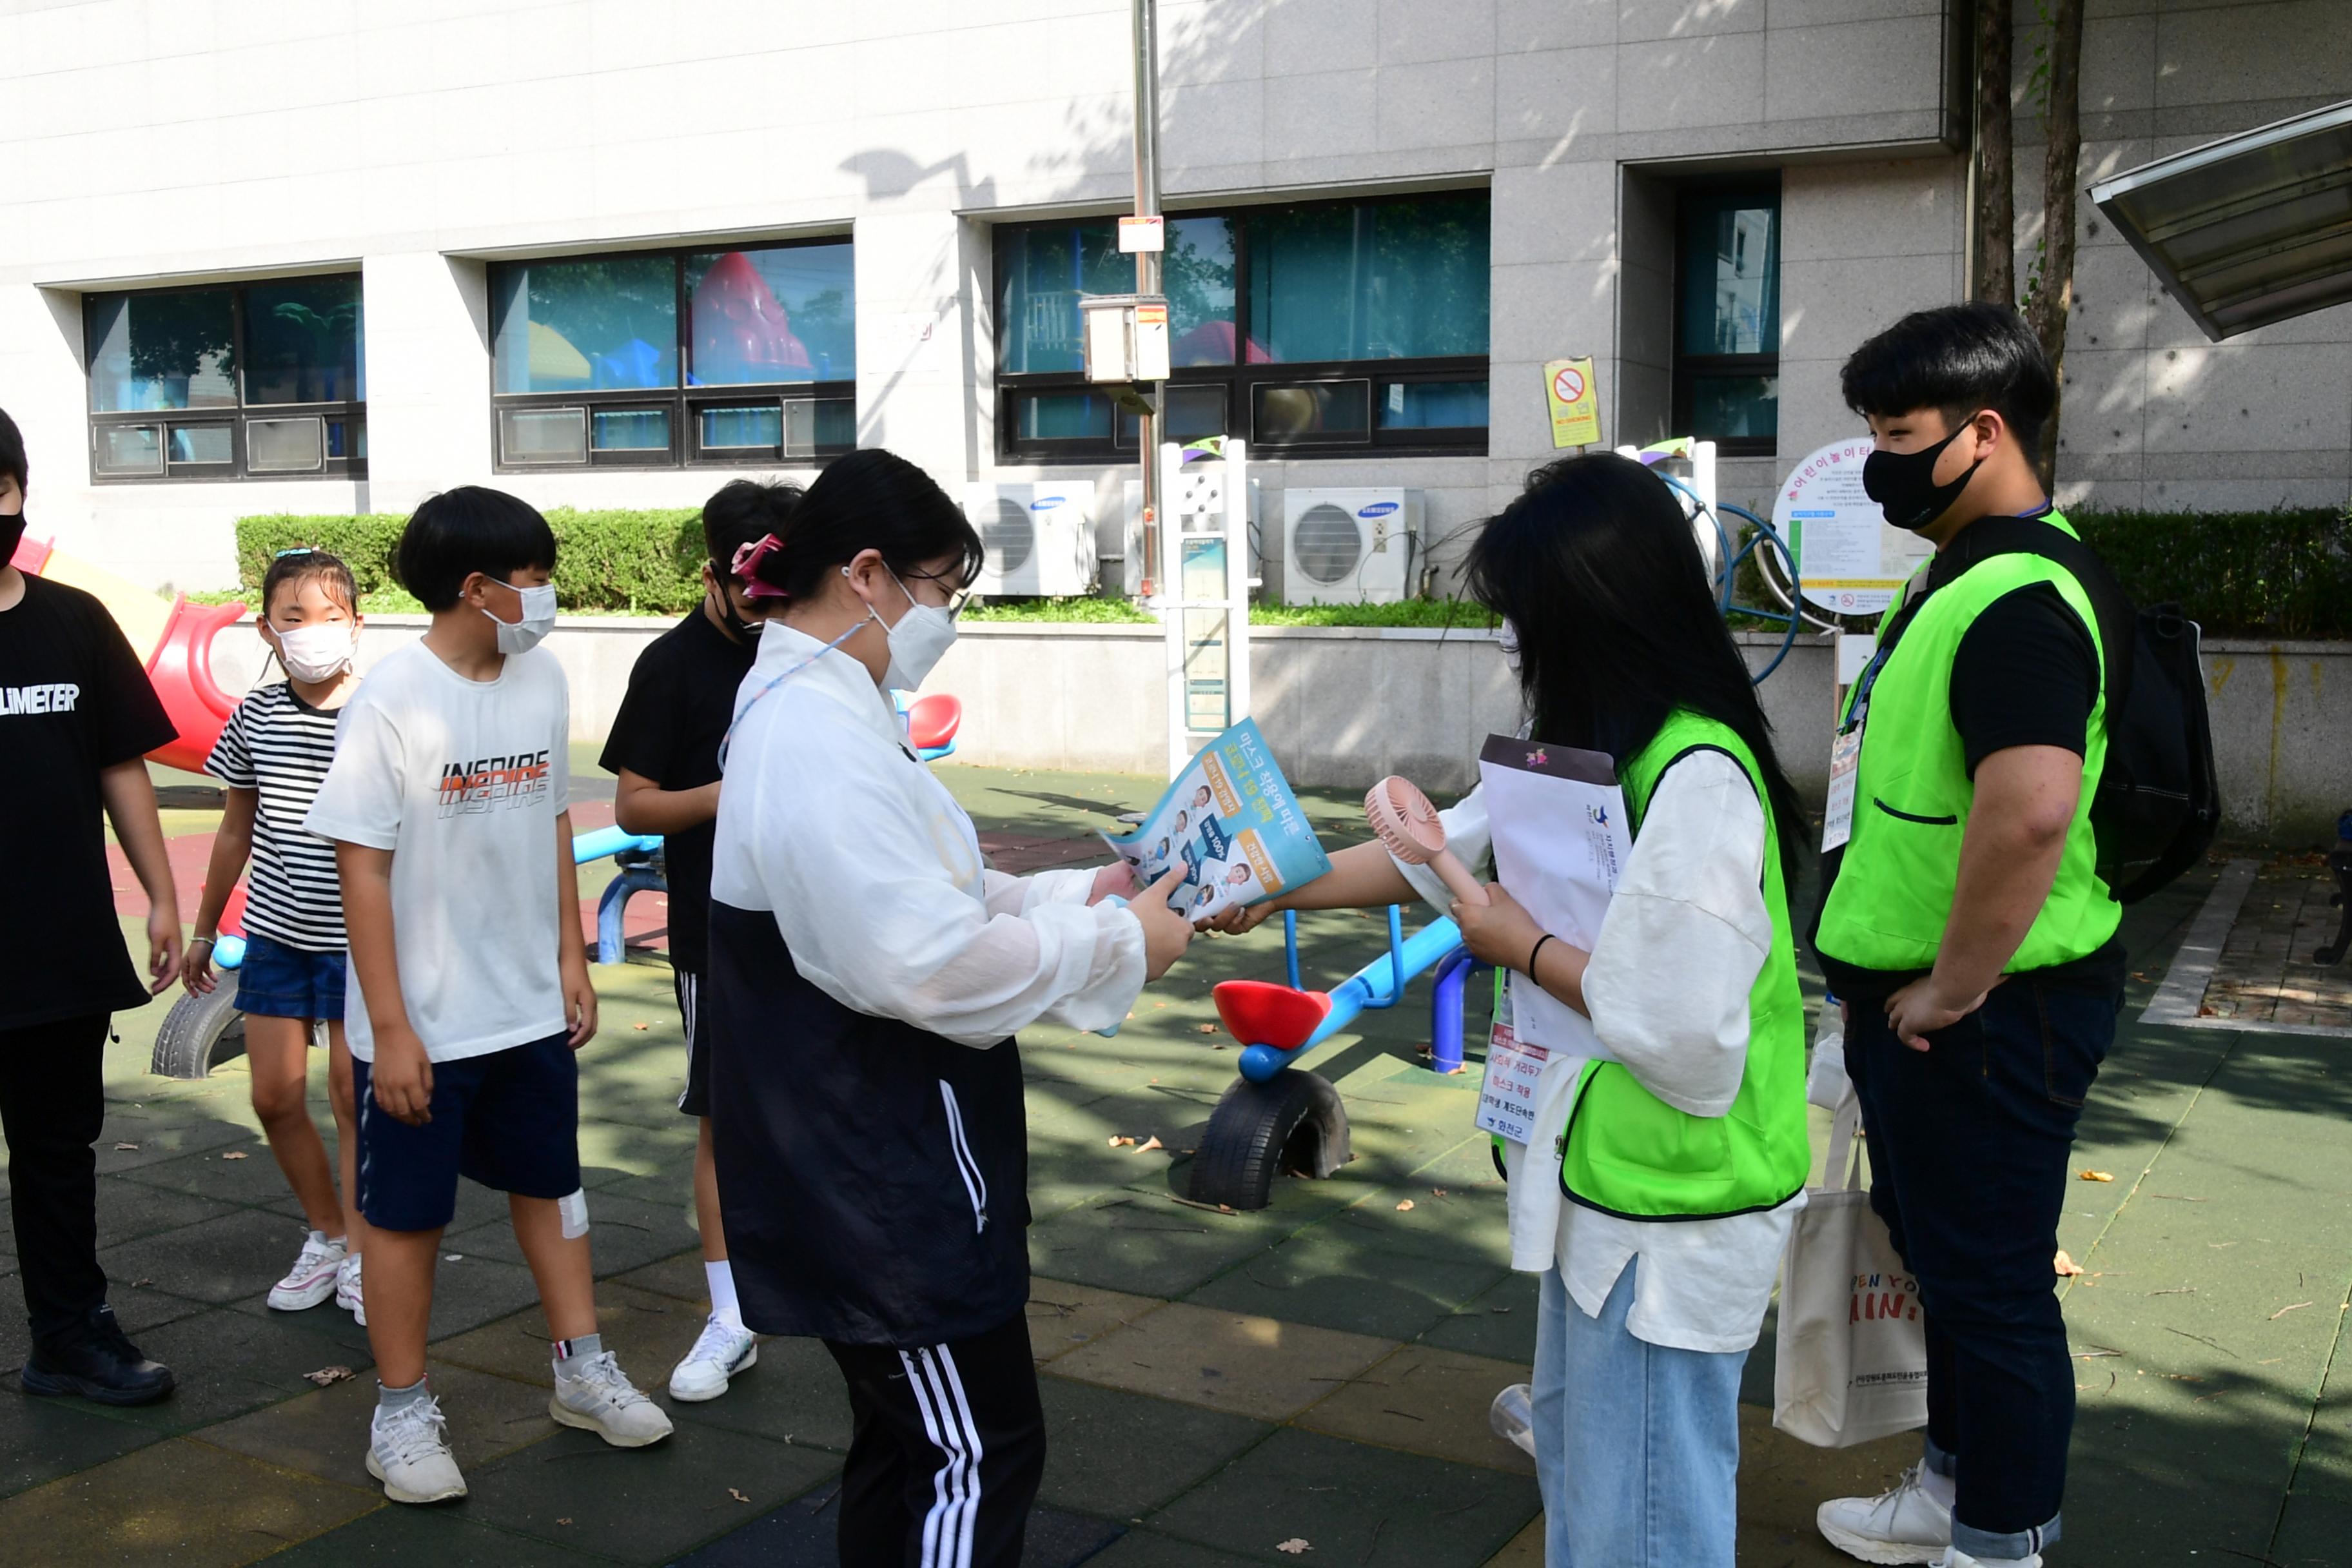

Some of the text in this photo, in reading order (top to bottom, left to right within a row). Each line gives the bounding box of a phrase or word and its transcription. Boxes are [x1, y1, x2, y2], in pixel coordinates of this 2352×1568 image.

[1239, 732, 1300, 836] 마스크 착용에 따른
[1211, 836, 1226, 858] 100%
[1605, 834, 1618, 874] 자치행정과
[1489, 1052, 1542, 1077] 사회적 거리두기
[1493, 1075, 1531, 1099] 마스크 착용
[1482, 1093, 1501, 1109] 대학생
[1498, 1120, 1523, 1139] 화천군
